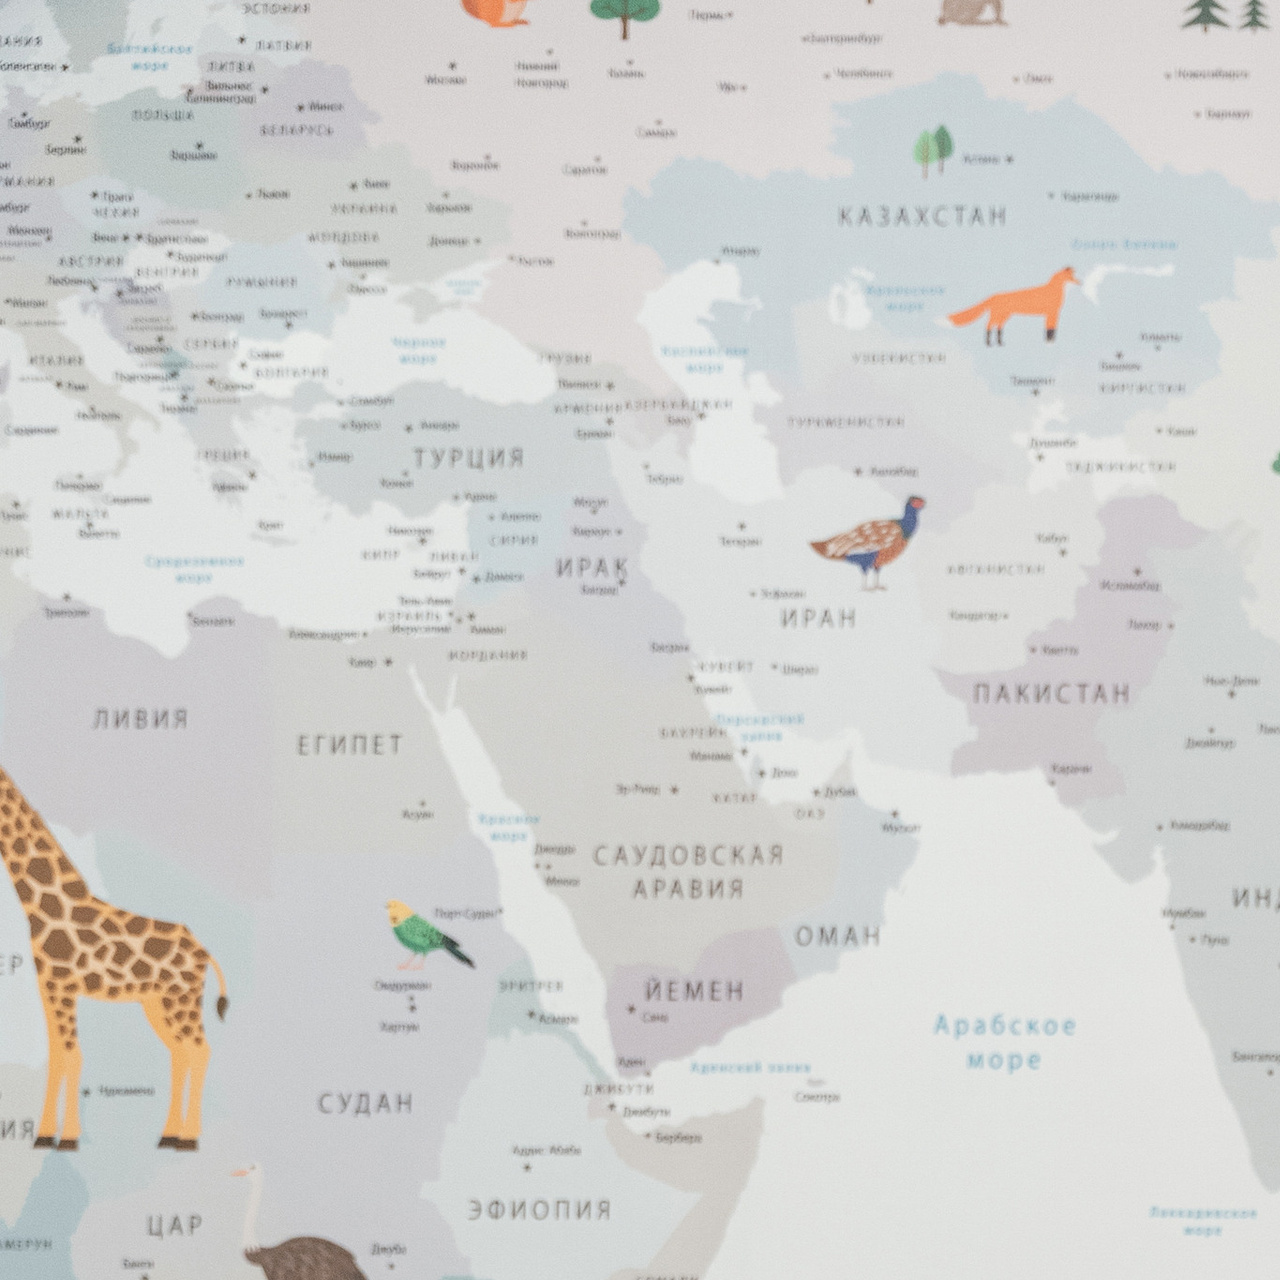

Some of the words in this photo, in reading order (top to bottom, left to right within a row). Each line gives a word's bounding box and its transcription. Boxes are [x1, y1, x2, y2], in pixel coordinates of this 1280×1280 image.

[838, 204, 1006, 227] КАЗАХСТАН
[414, 447, 523, 470] ТУРЦИЯ
[556, 558, 628, 578] ИРАК
[780, 608, 855, 628] ИРАН
[973, 682, 1129, 704] ПАКИСТАН
[93, 708, 187, 729] ЛИВИЯ
[296, 733, 403, 756] ЕГИПЕТ
[592, 844, 783, 866] САУДОВСКАЯ
[633, 878, 743, 899] АРАВИЯ
[794, 925, 879, 947] ОМАН
[644, 978, 743, 1002] ЙЕМЕН
[933, 1014, 1076, 1036] Арабское
[966, 1053, 1041, 1072] море
[317, 1092, 412, 1117] СУДАН
[468, 1199, 610, 1220] ЭФИОПИЯ
[147, 1214, 202, 1239] ЦАР
